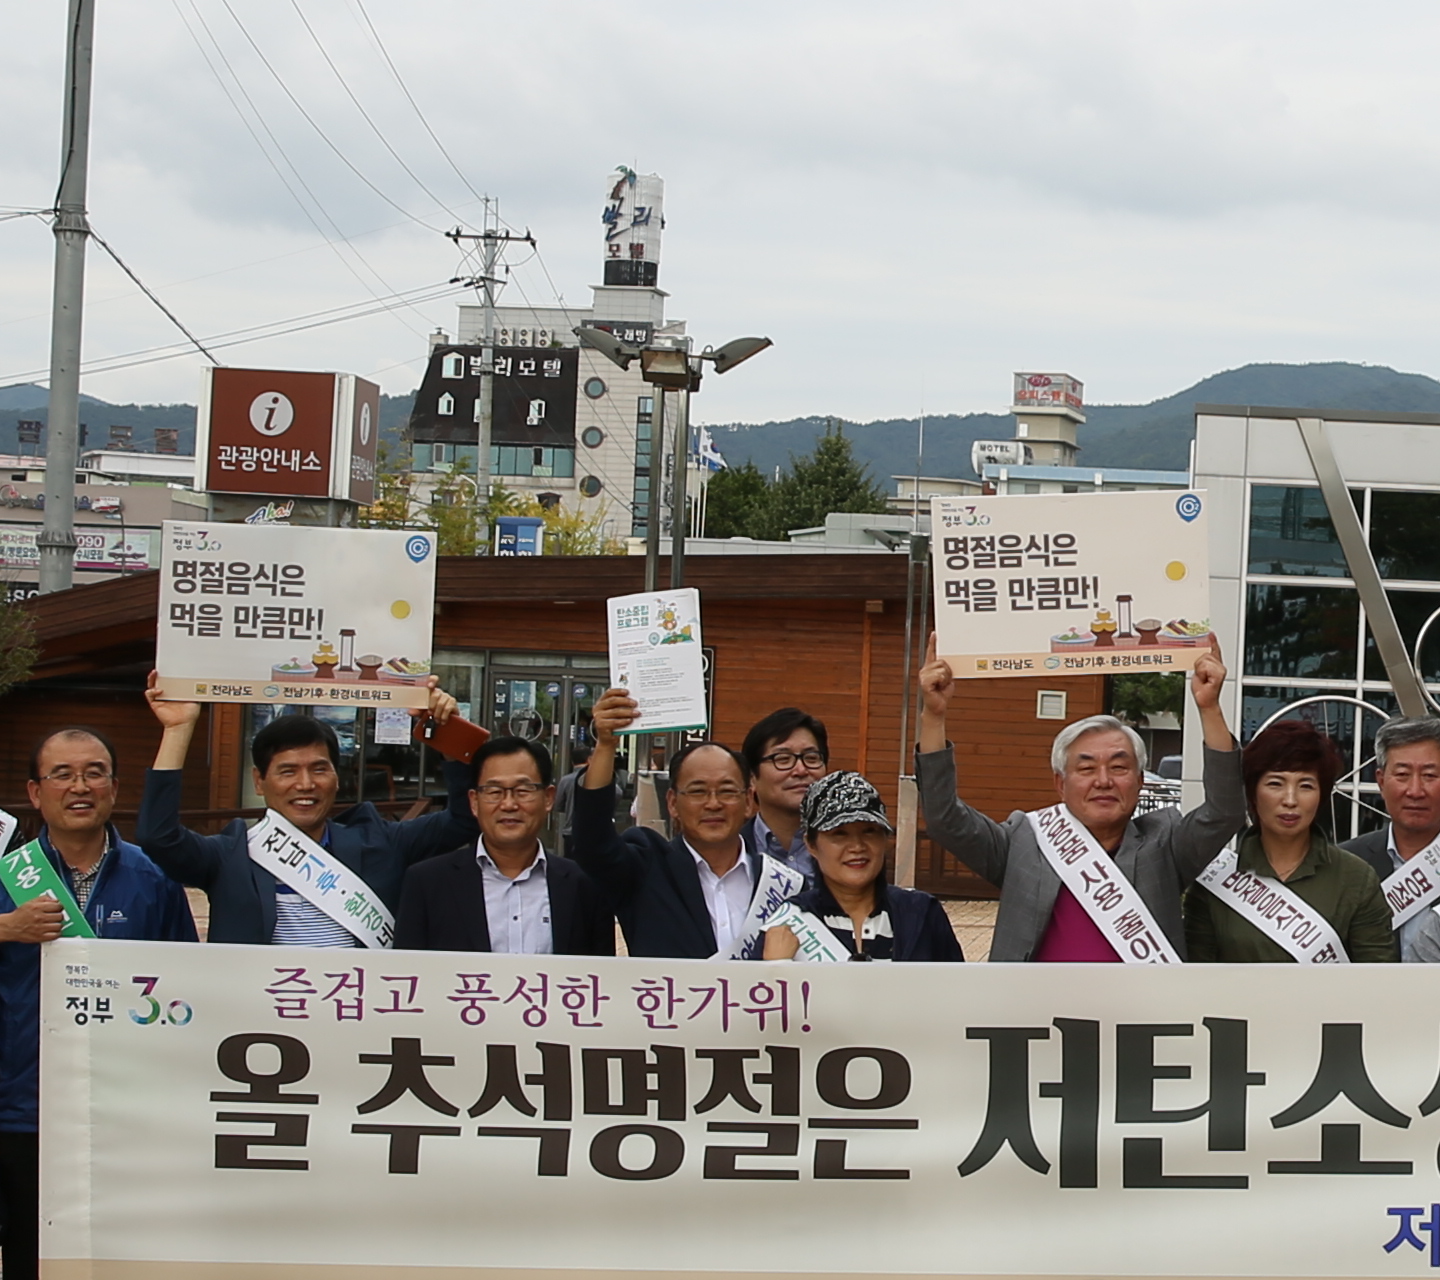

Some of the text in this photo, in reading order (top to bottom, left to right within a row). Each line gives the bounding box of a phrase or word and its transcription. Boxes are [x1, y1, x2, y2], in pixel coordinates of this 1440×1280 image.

[613, 328, 647, 342] 노래방
[217, 445, 322, 473] 관광안내소
[980, 444, 1010, 453] MOTEL
[943, 533, 1079, 571] 명절음식은
[171, 560, 306, 598] 명절음식은
[944, 575, 1100, 613] 먹을 만큼만!
[169, 603, 325, 641] 먹을 만큼만!
[991, 658, 1035, 671] 전라남도
[211, 684, 253, 697] 전라남도
[1079, 859, 1126, 913] 사용
[1221, 869, 1324, 950] 명절음식은
[65, 975, 194, 1027] 정부 3.0
[264, 966, 814, 1035] 즐겁고 풍성한 한가위!
[209, 1032, 321, 1173] 올
[350, 1035, 921, 1182] 추석명절은
